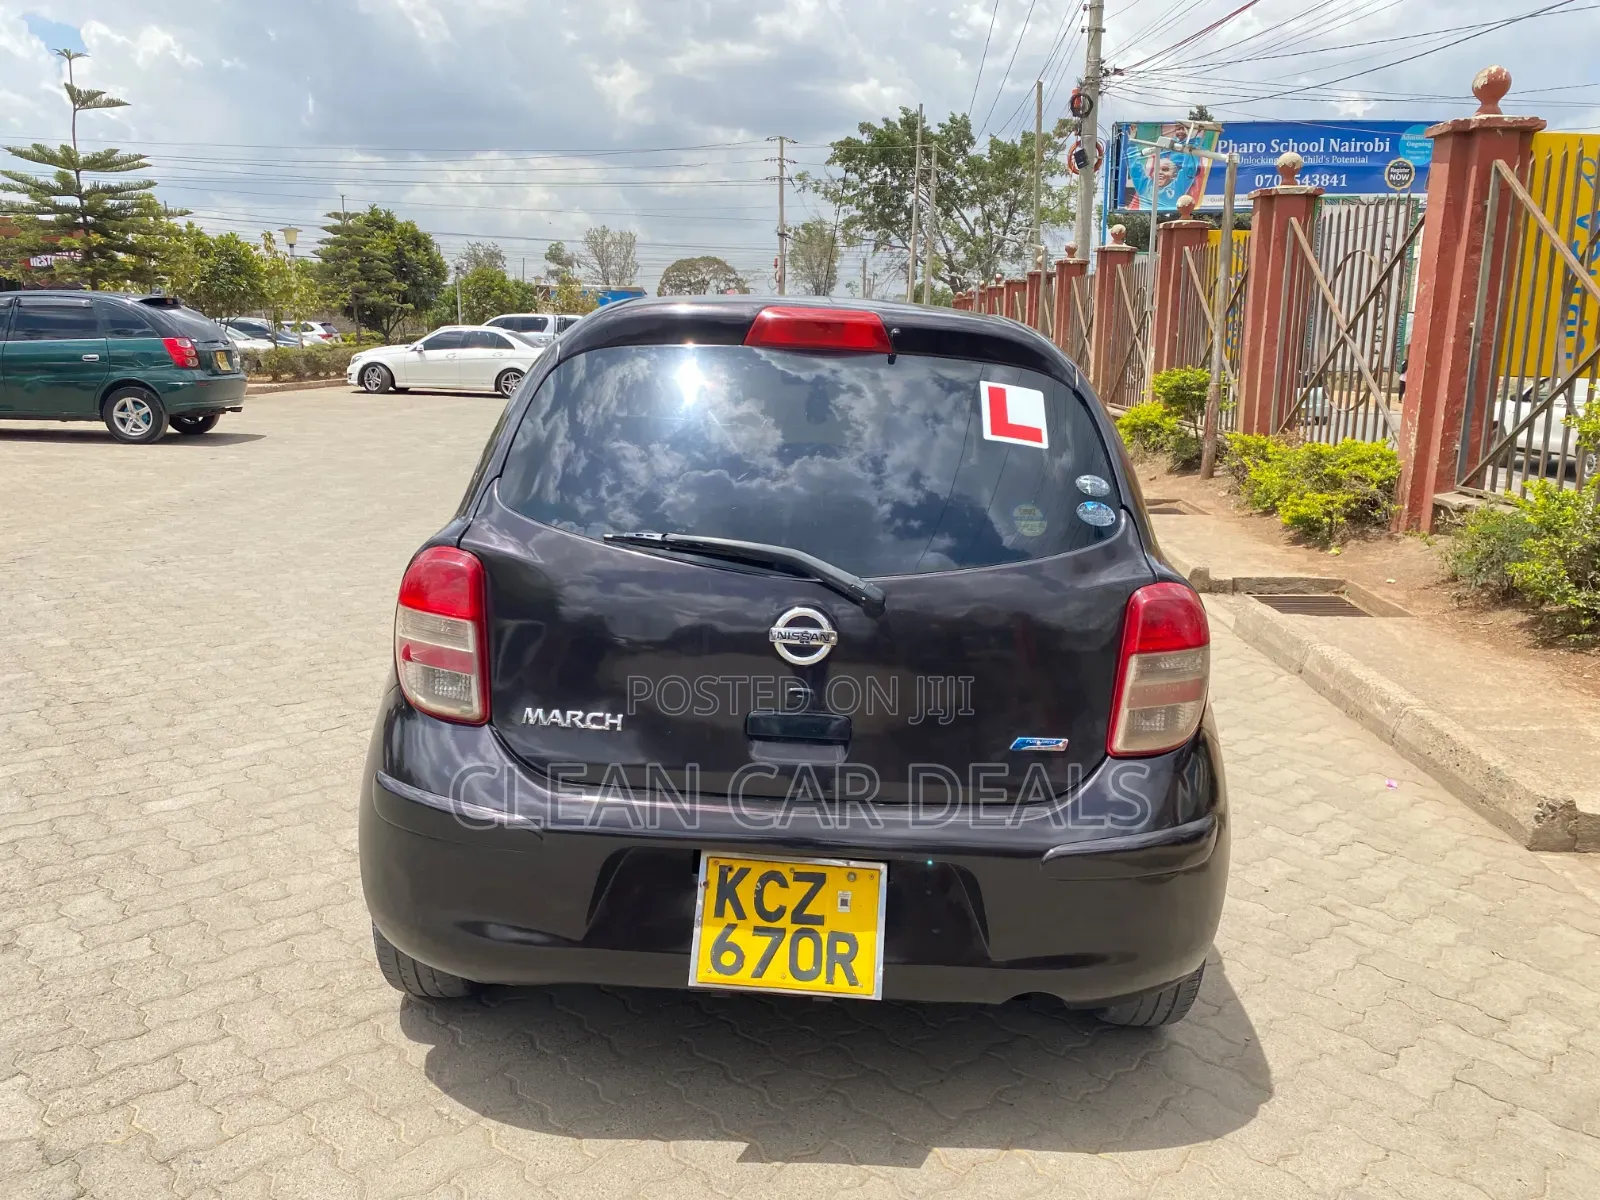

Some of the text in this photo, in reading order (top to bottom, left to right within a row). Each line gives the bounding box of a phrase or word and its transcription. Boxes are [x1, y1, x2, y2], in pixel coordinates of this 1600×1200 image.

[1218, 138, 1390, 153] Pharo School Nairobi
[1302, 156, 1329, 164] Child's
[1331, 156, 1369, 164] Potential
[1389, 173, 1410, 181] NOW
[1390, 167, 1410, 175] Register
[988, 386, 1043, 443] L
[776, 630, 830, 644] NISSAN
[521, 707, 624, 731] MARCH
[713, 865, 827, 926] KCZ
[710, 923, 860, 987] 670R
